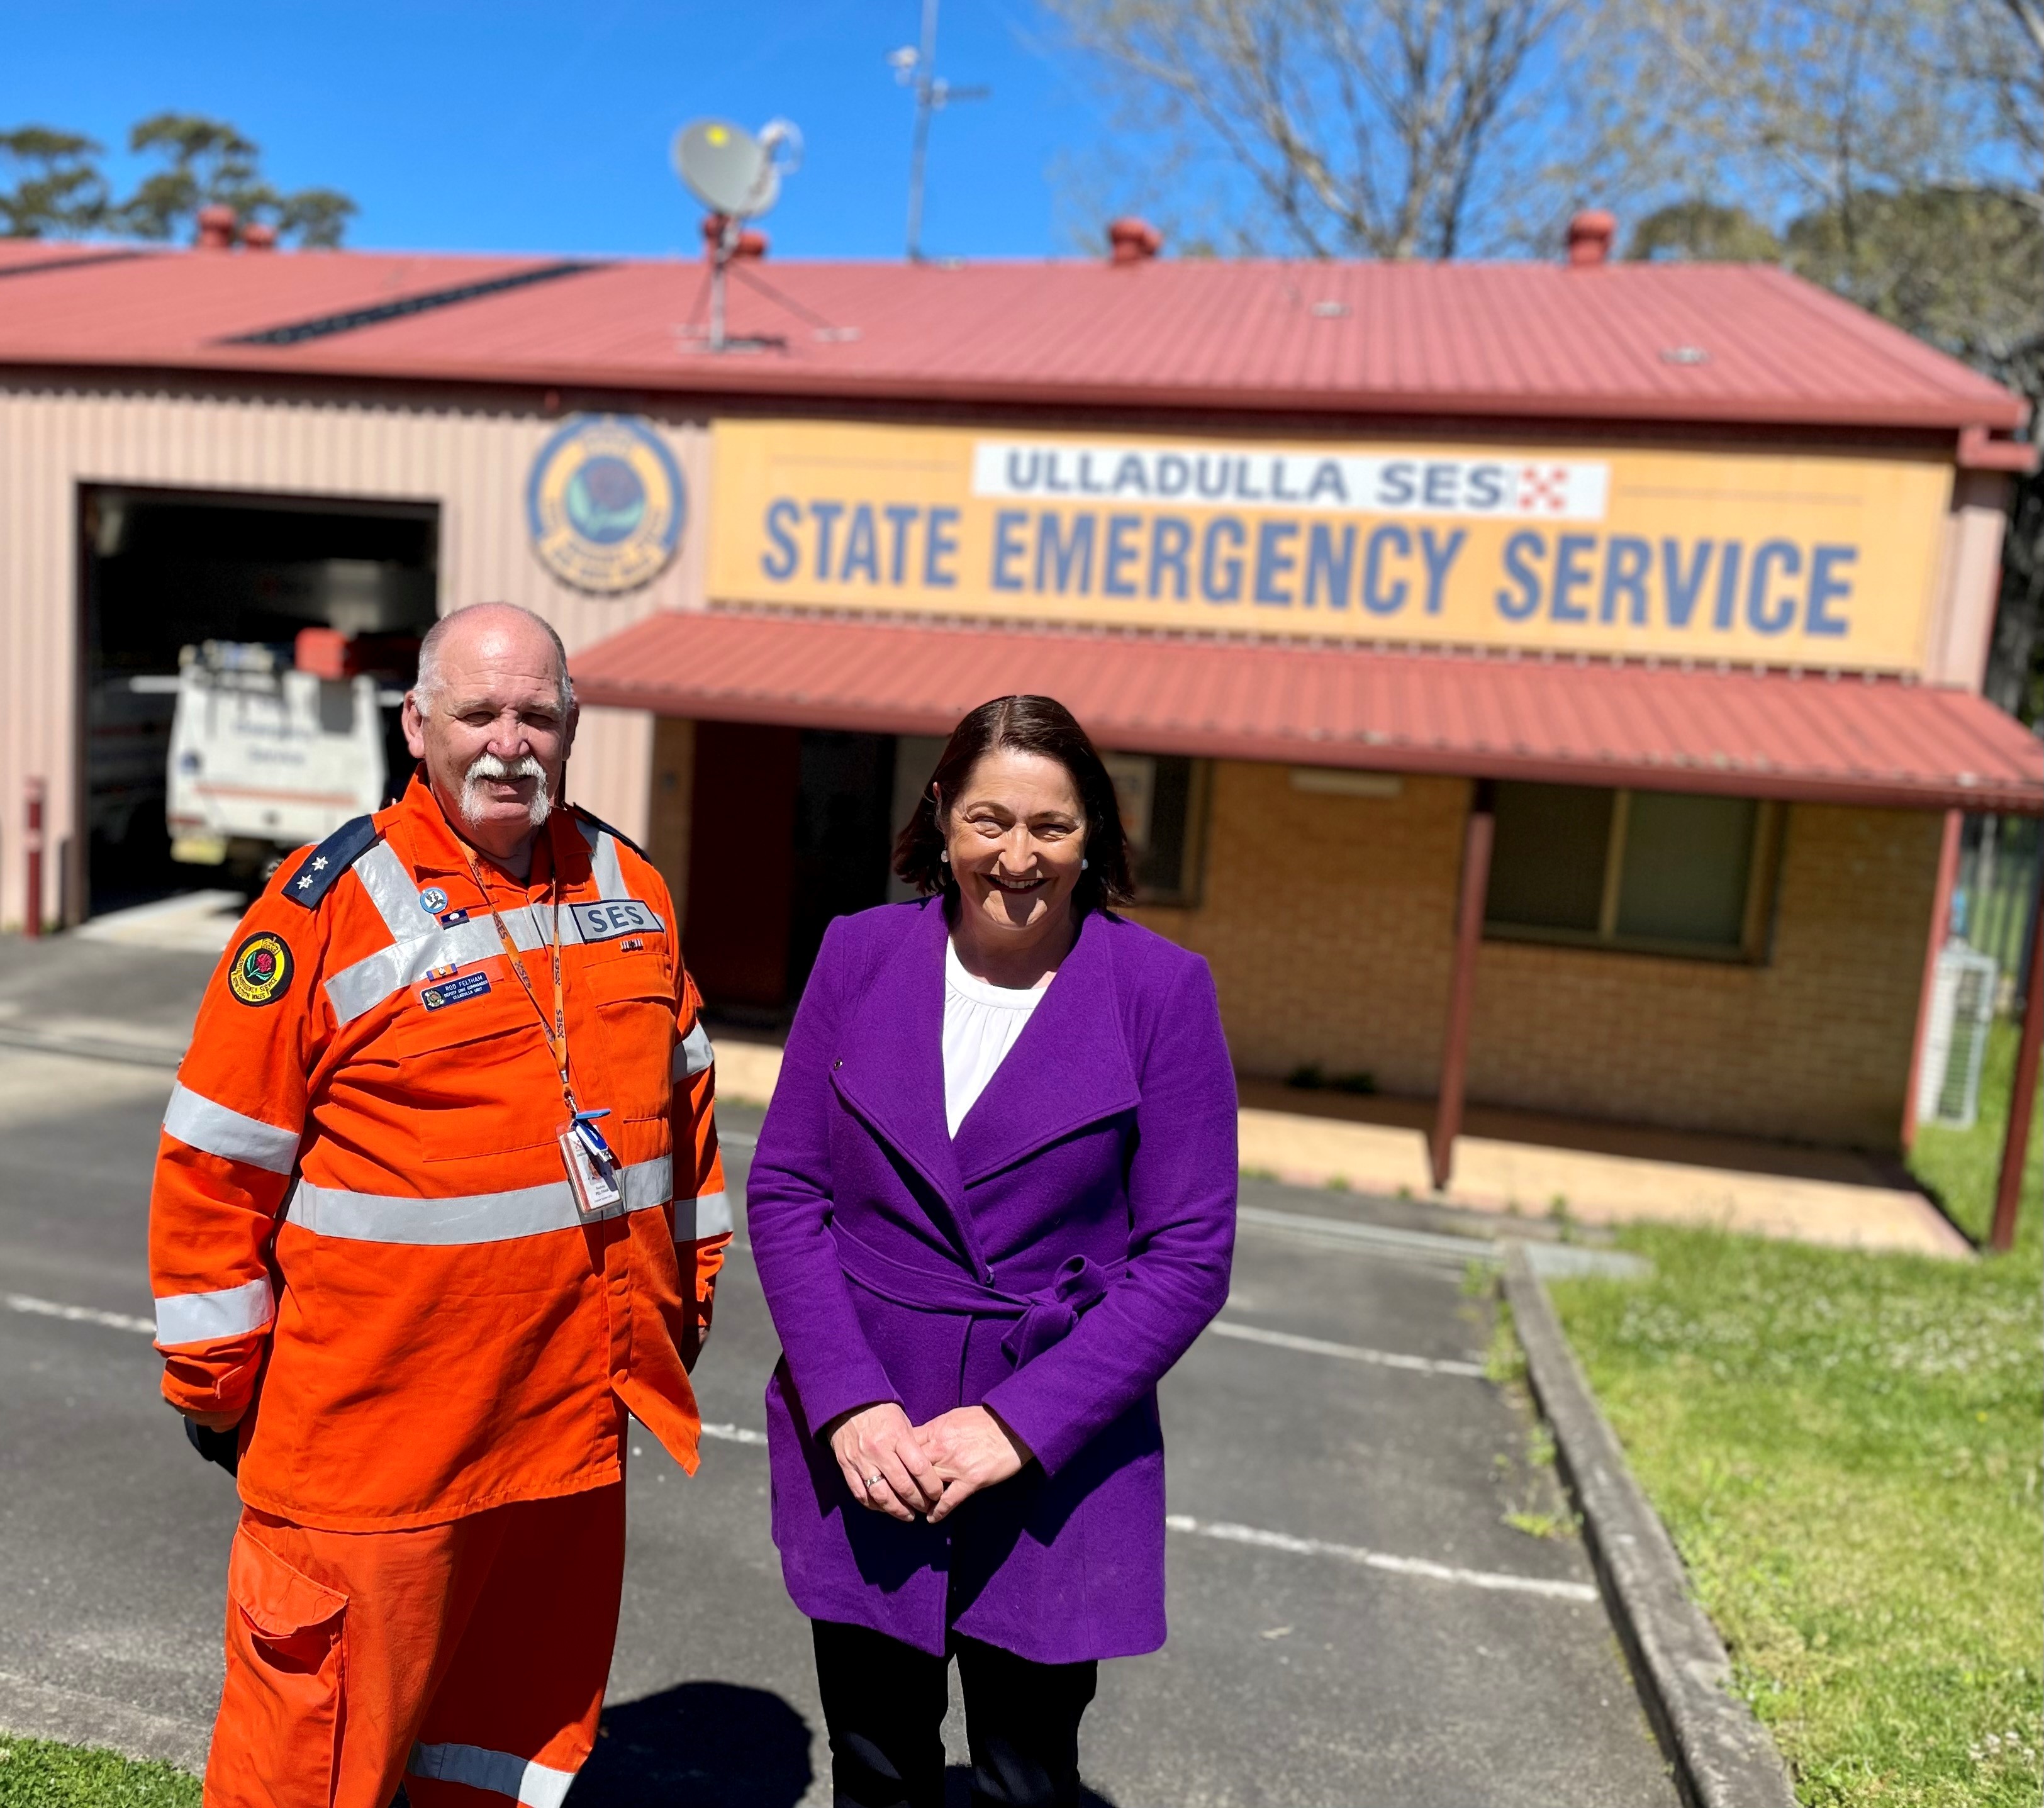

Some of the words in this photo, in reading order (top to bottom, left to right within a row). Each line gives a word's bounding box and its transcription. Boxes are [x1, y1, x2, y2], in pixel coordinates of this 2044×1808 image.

[1006, 447, 1349, 503] ULLADULLA
[1376, 460, 1505, 510] SES
[761, 495, 962, 589] STATE
[991, 509, 1469, 617] EMERGENCY
[1495, 529, 1859, 639] SERVICE
[588, 905, 644, 933] SES
[445, 983, 457, 992] ROD
[458, 974, 483, 987] FELTHAM
